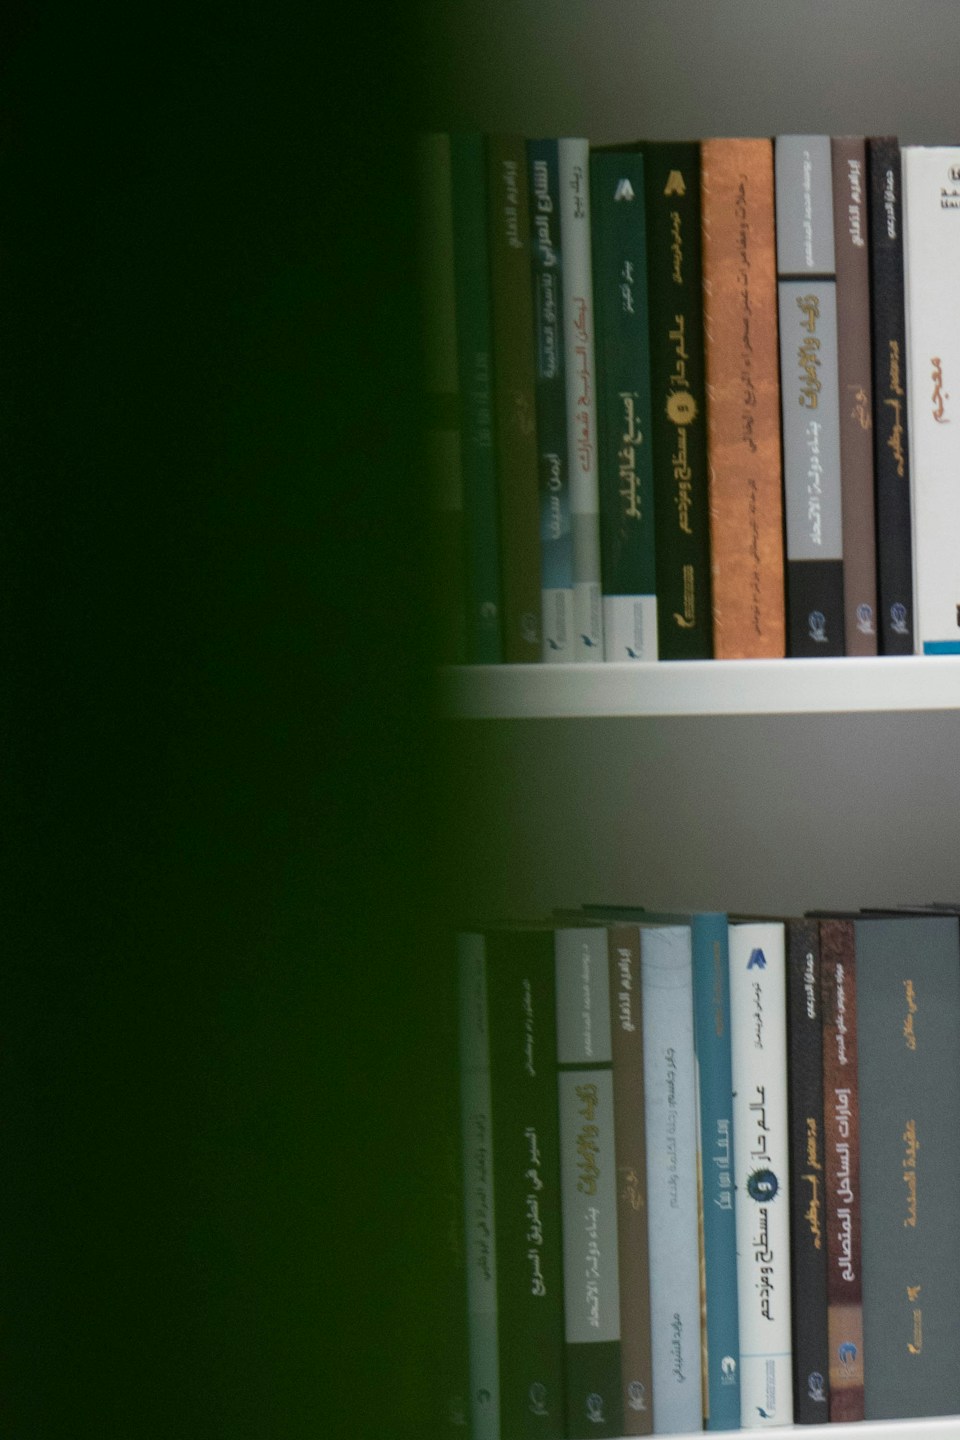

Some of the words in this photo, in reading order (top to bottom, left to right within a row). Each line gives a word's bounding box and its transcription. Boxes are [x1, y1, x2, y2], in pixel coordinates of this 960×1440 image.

[931, 358, 949, 423] معجم
[836, 1143, 853, 1203] الساحل
[837, 1208, 854, 1281] المتصالح
